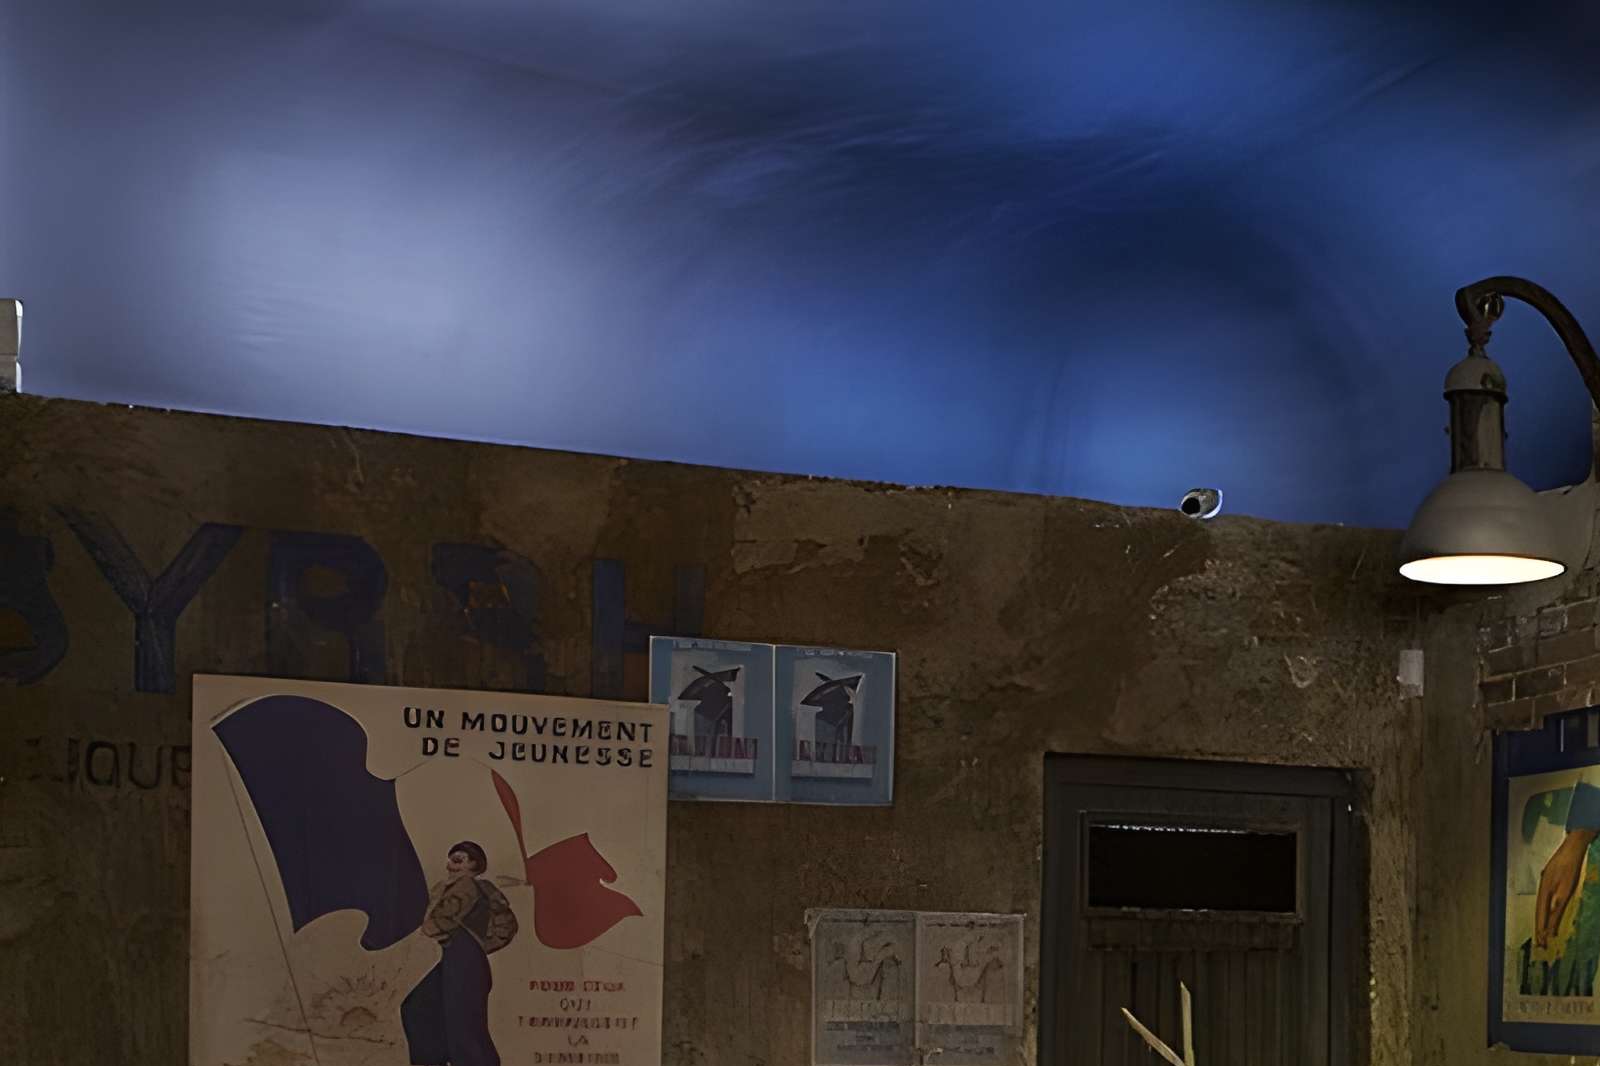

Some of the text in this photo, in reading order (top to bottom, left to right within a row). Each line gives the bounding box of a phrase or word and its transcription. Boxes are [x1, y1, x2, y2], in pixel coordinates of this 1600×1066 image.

[403, 706, 654, 743] UN MOUVEMENT
[422, 736, 460, 759] DE
[488, 740, 654, 770] JEUNESSE
